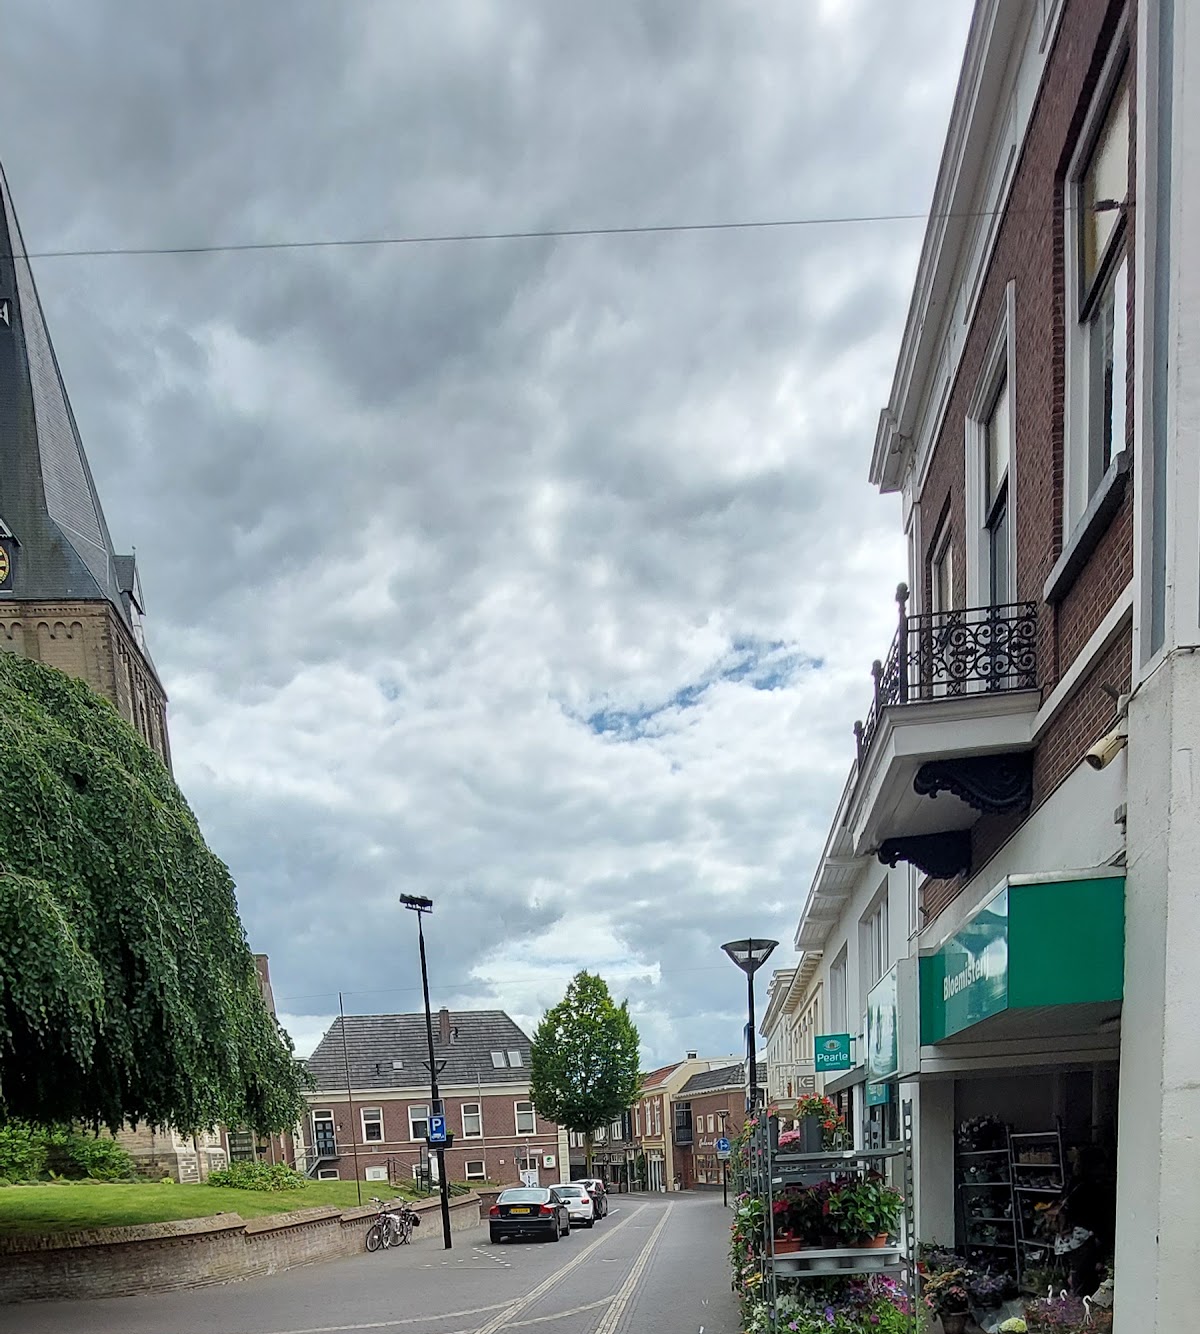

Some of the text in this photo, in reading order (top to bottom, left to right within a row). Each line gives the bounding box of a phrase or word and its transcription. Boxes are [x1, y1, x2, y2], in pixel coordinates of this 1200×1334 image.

[943, 946, 989, 1001] Bloemisterij
[817, 1052, 848, 1062] Pearle
[431, 1118, 442, 1131] P
